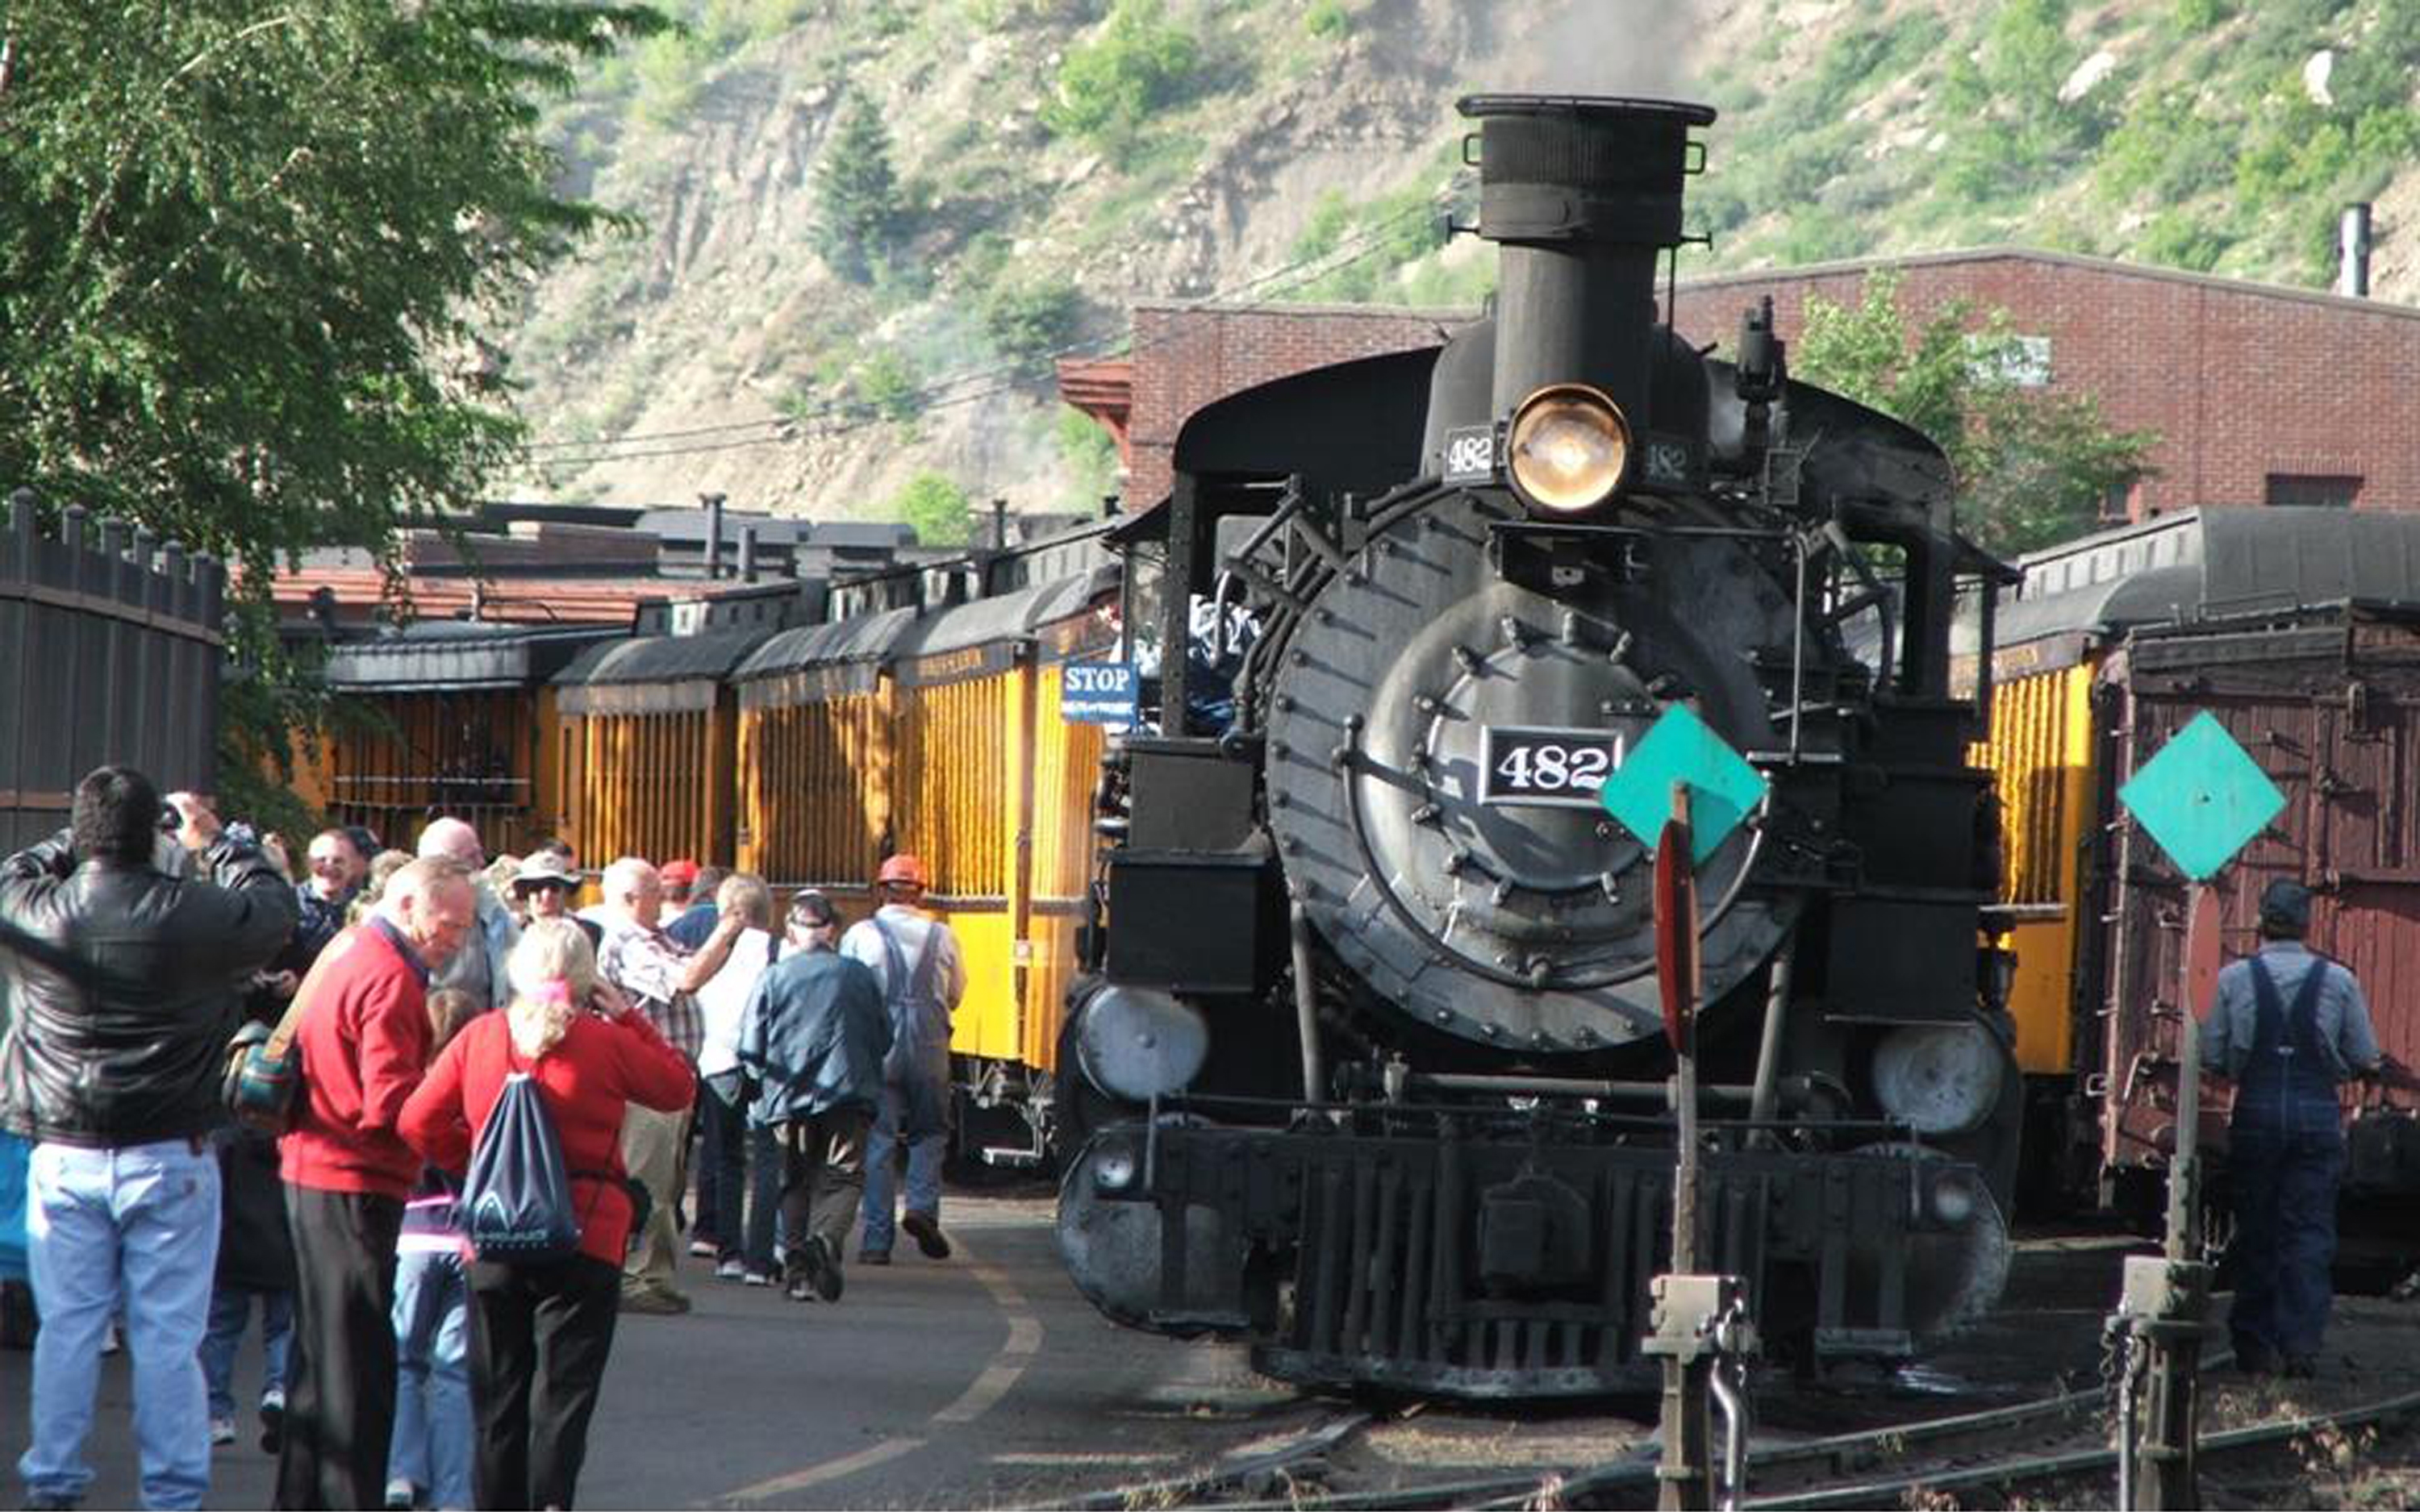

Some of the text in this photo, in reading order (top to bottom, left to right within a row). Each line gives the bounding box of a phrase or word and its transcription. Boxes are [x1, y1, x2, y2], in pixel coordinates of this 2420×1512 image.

[1450, 439, 1492, 473] 482
[1065, 667, 1130, 691] STOP
[1496, 745, 1608, 789] 482
